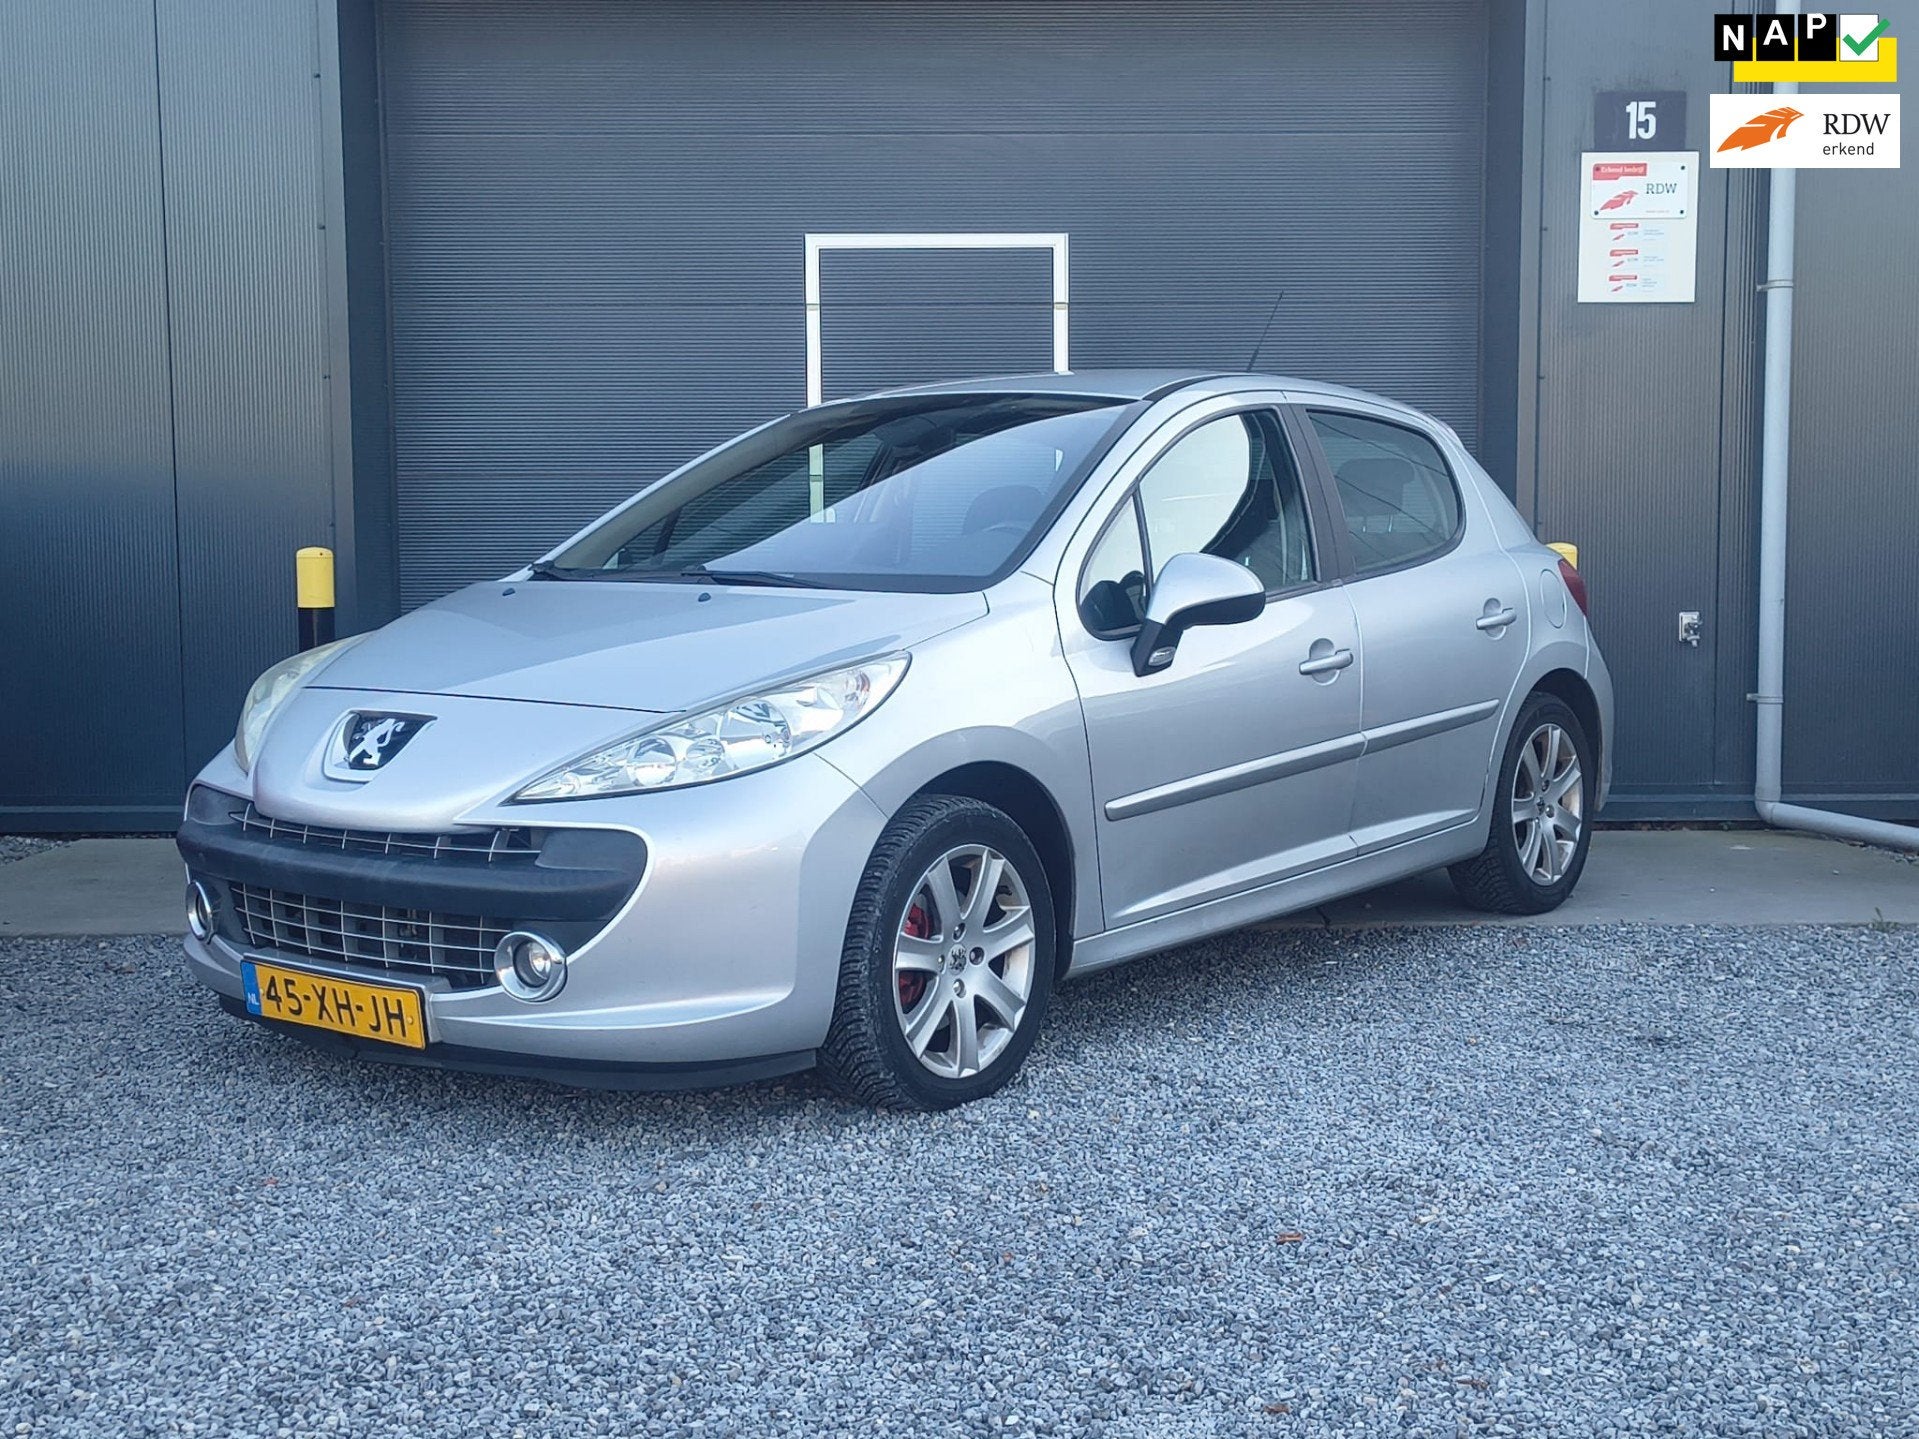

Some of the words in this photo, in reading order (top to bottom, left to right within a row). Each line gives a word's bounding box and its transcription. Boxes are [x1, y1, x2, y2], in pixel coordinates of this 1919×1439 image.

[1625, 101, 1657, 140] 15
[1645, 182, 1677, 195] RDW
[247, 992, 260, 1006] NL
[266, 974, 407, 1038] 45-XH-JH
